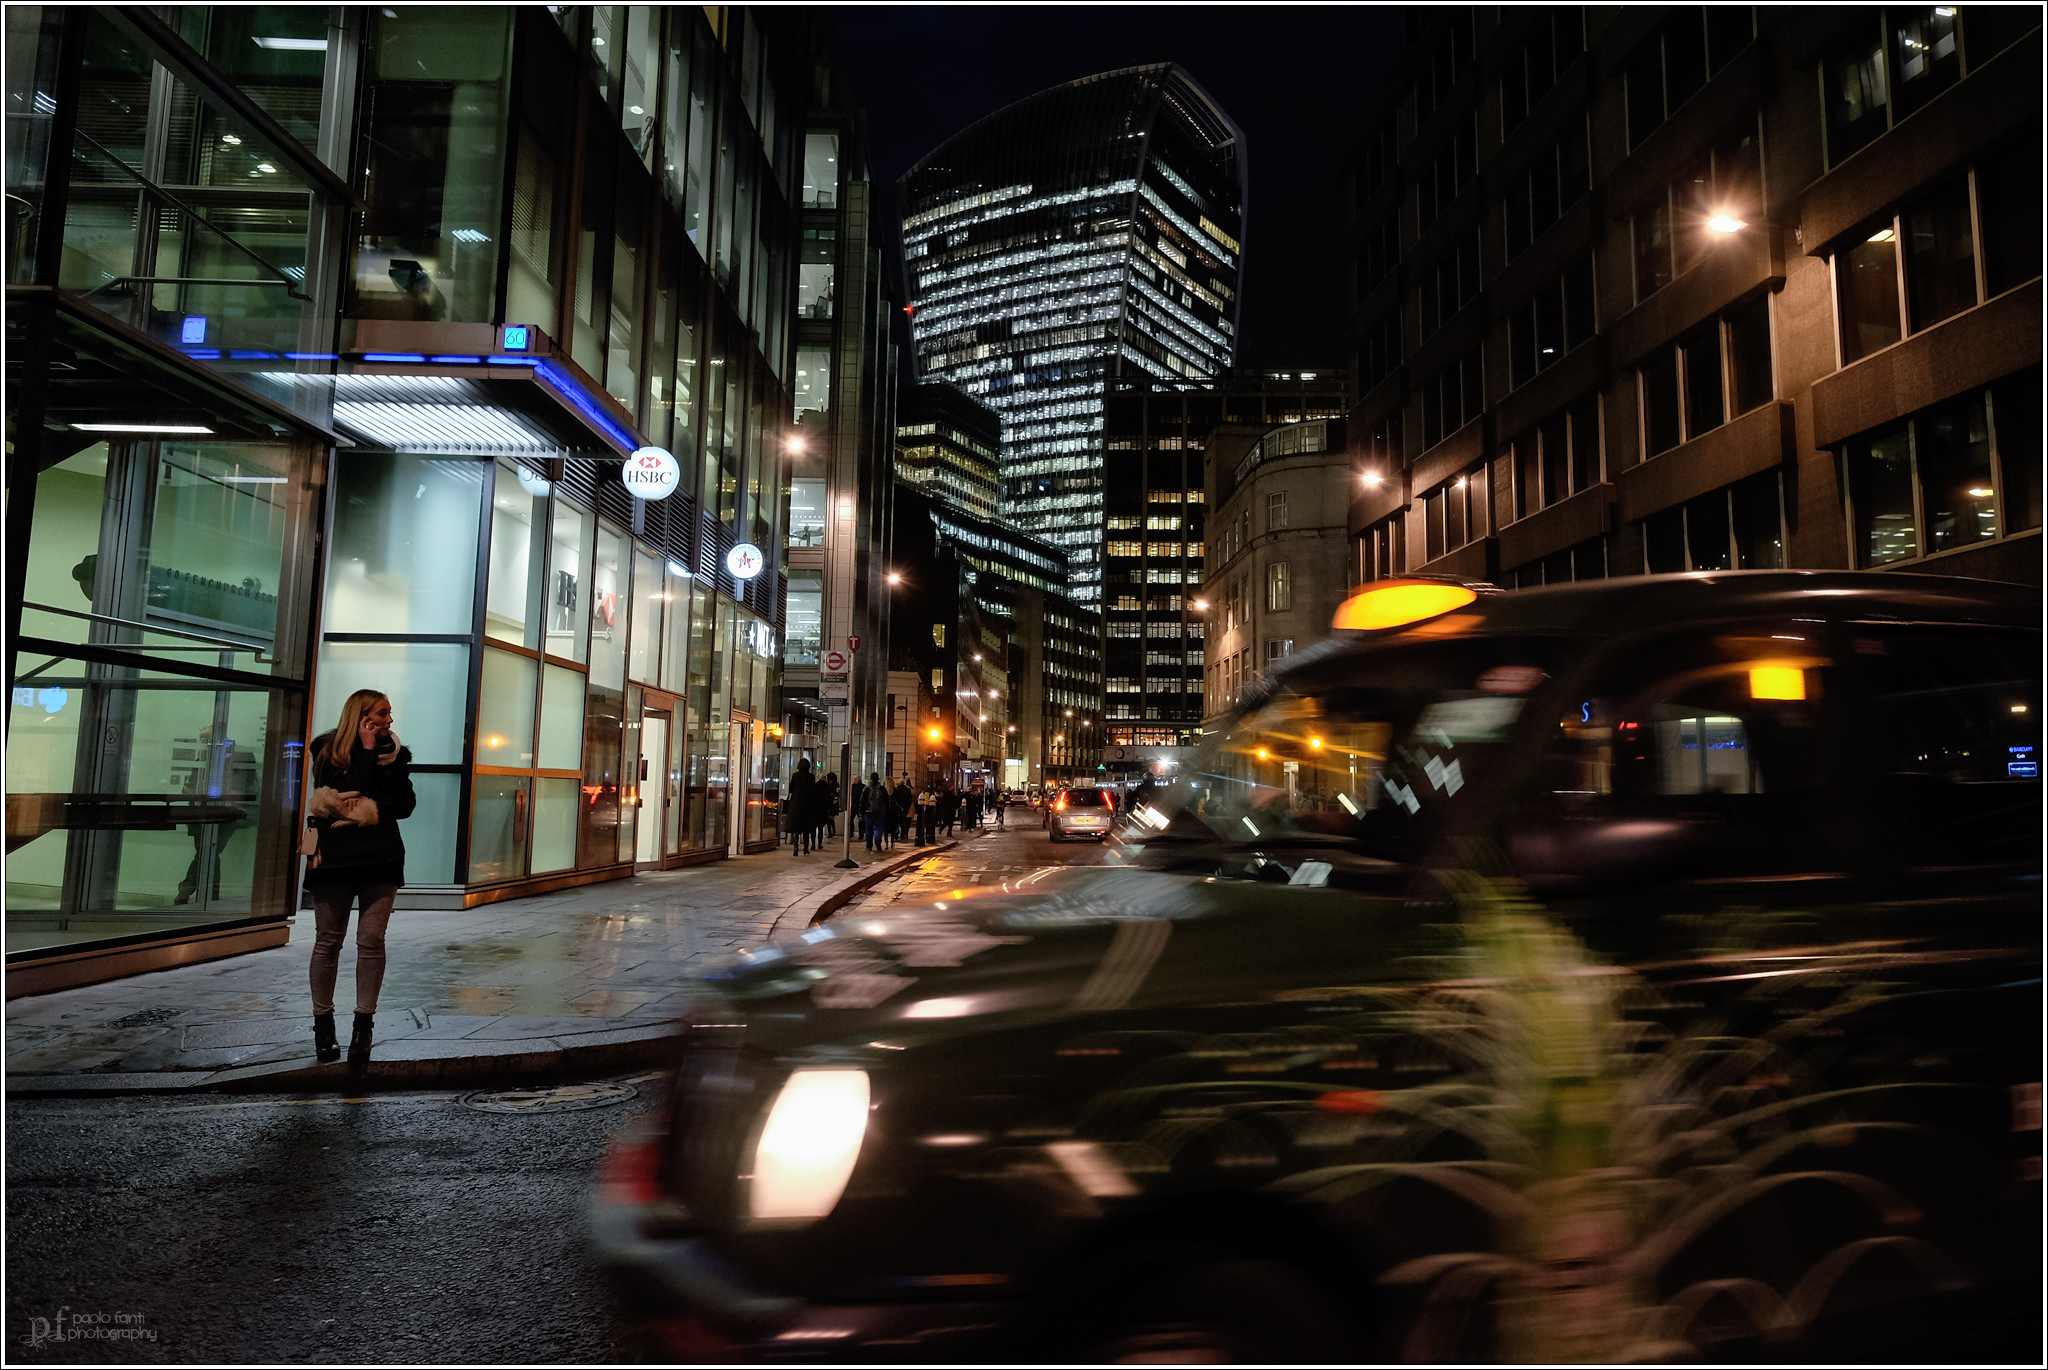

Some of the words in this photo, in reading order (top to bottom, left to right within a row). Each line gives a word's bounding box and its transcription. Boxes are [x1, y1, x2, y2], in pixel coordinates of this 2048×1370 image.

[506, 331, 525, 345] 60
[627, 470, 672, 485] HSBC
[166, 567, 180, 579] 60
[185, 572, 251, 598] FENCHURCH
[850, 637, 859, 649] T
